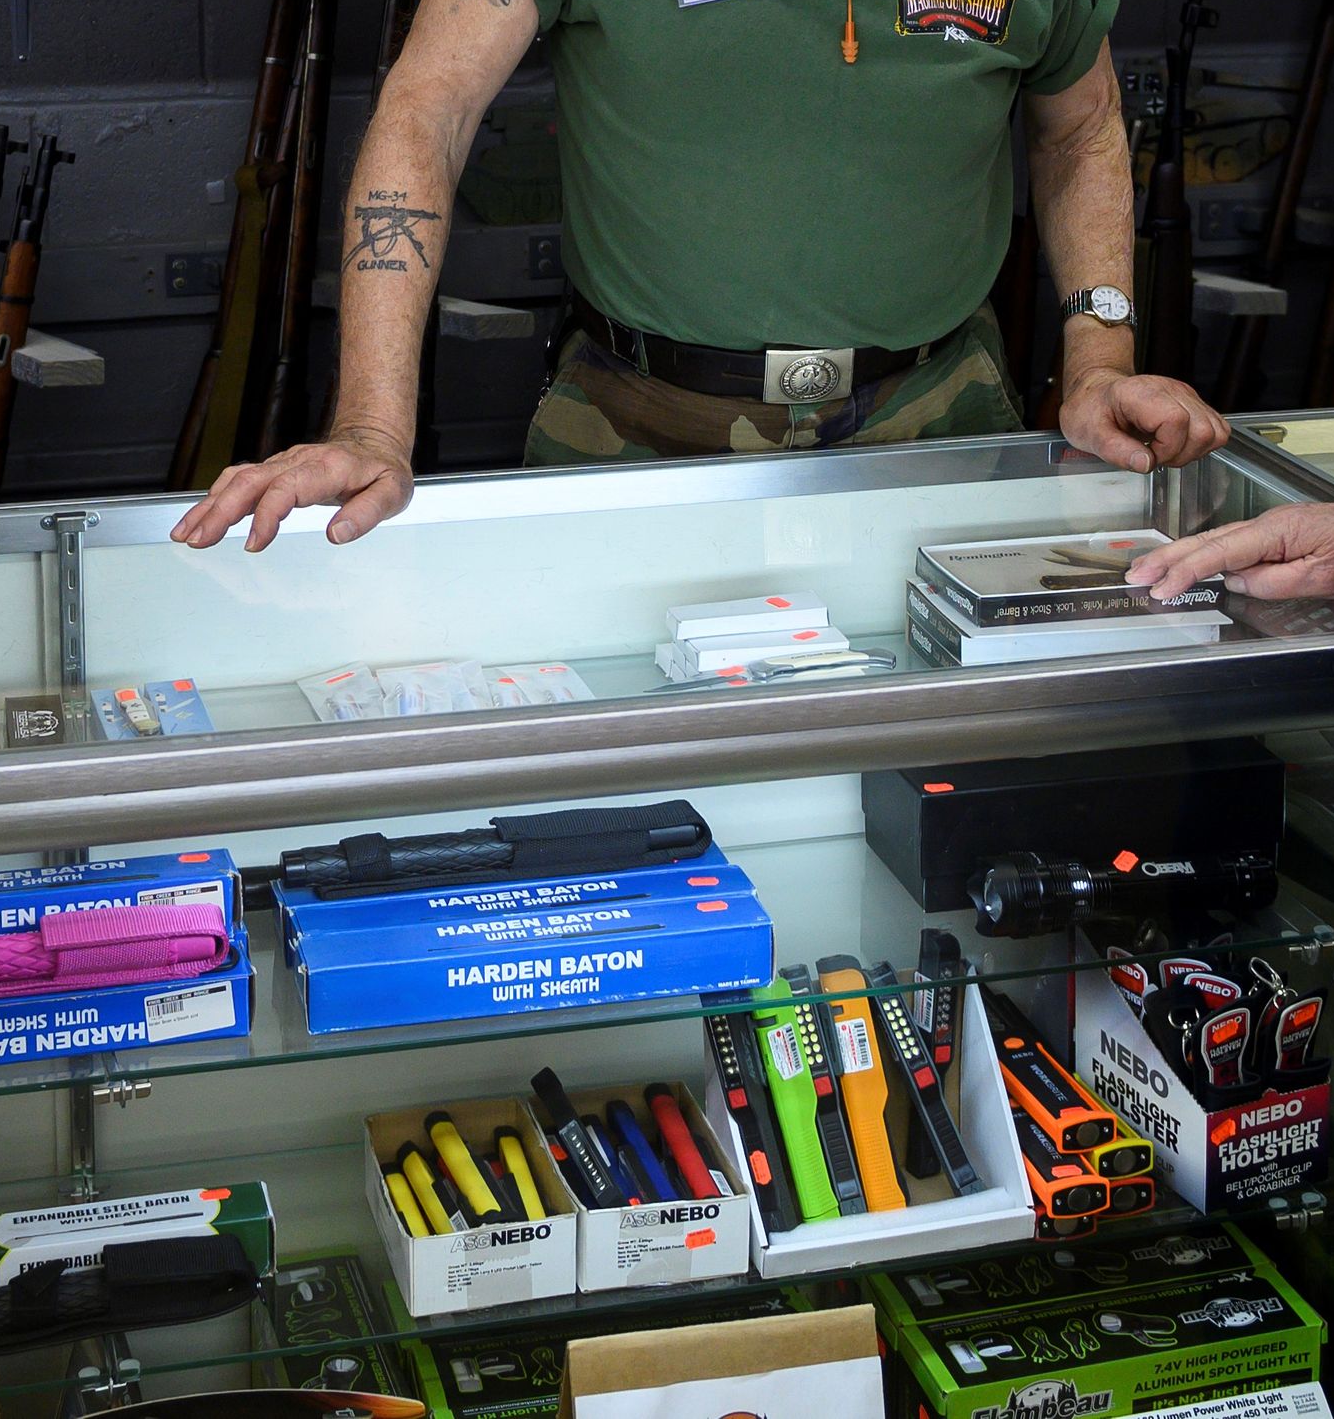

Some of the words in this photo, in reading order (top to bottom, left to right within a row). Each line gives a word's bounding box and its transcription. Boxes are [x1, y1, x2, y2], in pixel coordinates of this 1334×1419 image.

[368, 191, 407, 202] MG-34
[357, 260, 408, 272] GUNNER
[1031, 603, 1053, 615] Stock
[1131, 595, 1149, 607] 2011
[21, 873, 83, 886] SHEATH
[47, 861, 127, 878] BATON
[428, 889, 531, 909] HARDEN
[535, 880, 618, 897] BATON
[475, 900, 520, 912] WITH
[523, 893, 581, 908] SHEATH
[436, 916, 545, 937] HARDEN
[548, 909, 632, 926] BATON
[485, 929, 527, 942] WITH
[534, 923, 593, 939] SHEATH
[447, 958, 553, 988] HARDEN
[560, 949, 644, 977] BATON
[492, 983, 535, 1002] WITH
[540, 977, 600, 1000] SHEATH
[1195, 980, 1233, 997] NEBO
[55, 1008, 100, 1025] WITH
[36, 1021, 146, 1053] HARDEN
[1100, 1029, 1170, 1099] NEBO
[1092, 1058, 1181, 1133] FLASHLIGHT
[1094, 1074, 1180, 1155] HOLSTER
[1241, 1099, 1303, 1130] NEBO
[1218, 1118, 1323, 1158] FLASHLIGHT
[1221, 1132, 1320, 1173] HOLSTER
[1225, 1165, 1290, 1194] BELT/POCKET
[1291, 1161, 1313, 1179] CLIP
[1260, 1161, 1279, 1173] with
[1246, 1175, 1301, 1199] CARABINER
[13, 1207, 100, 1224] EXPANDABLE
[103, 1201, 143, 1214] STEEL
[145, 1195, 191, 1209] BATON
[59, 1216, 94, 1225] WITH
[97, 1209, 148, 1221] SHEATH
[1154, 1358, 1184, 1374] 7.4V
[1185, 1352, 1218, 1369] HIGH
[1221, 1341, 1288, 1363] POWERED
[1134, 1371, 1206, 1394] ALUMINUM
[1209, 1363, 1244, 1379] SPOT
[1246, 1355, 1286, 1373] LIGHT
[1288, 1351, 1312, 1365] KIT
[1156, 1406, 1193, 1419] Lumen
[1193, 1400, 1225, 1417] Power
[1226, 1396, 1257, 1412] White
[1257, 1392, 1284, 1407] Light
[1243, 1406, 1261, 1419] 450
[1261, 1403, 1289, 1416] Yards
